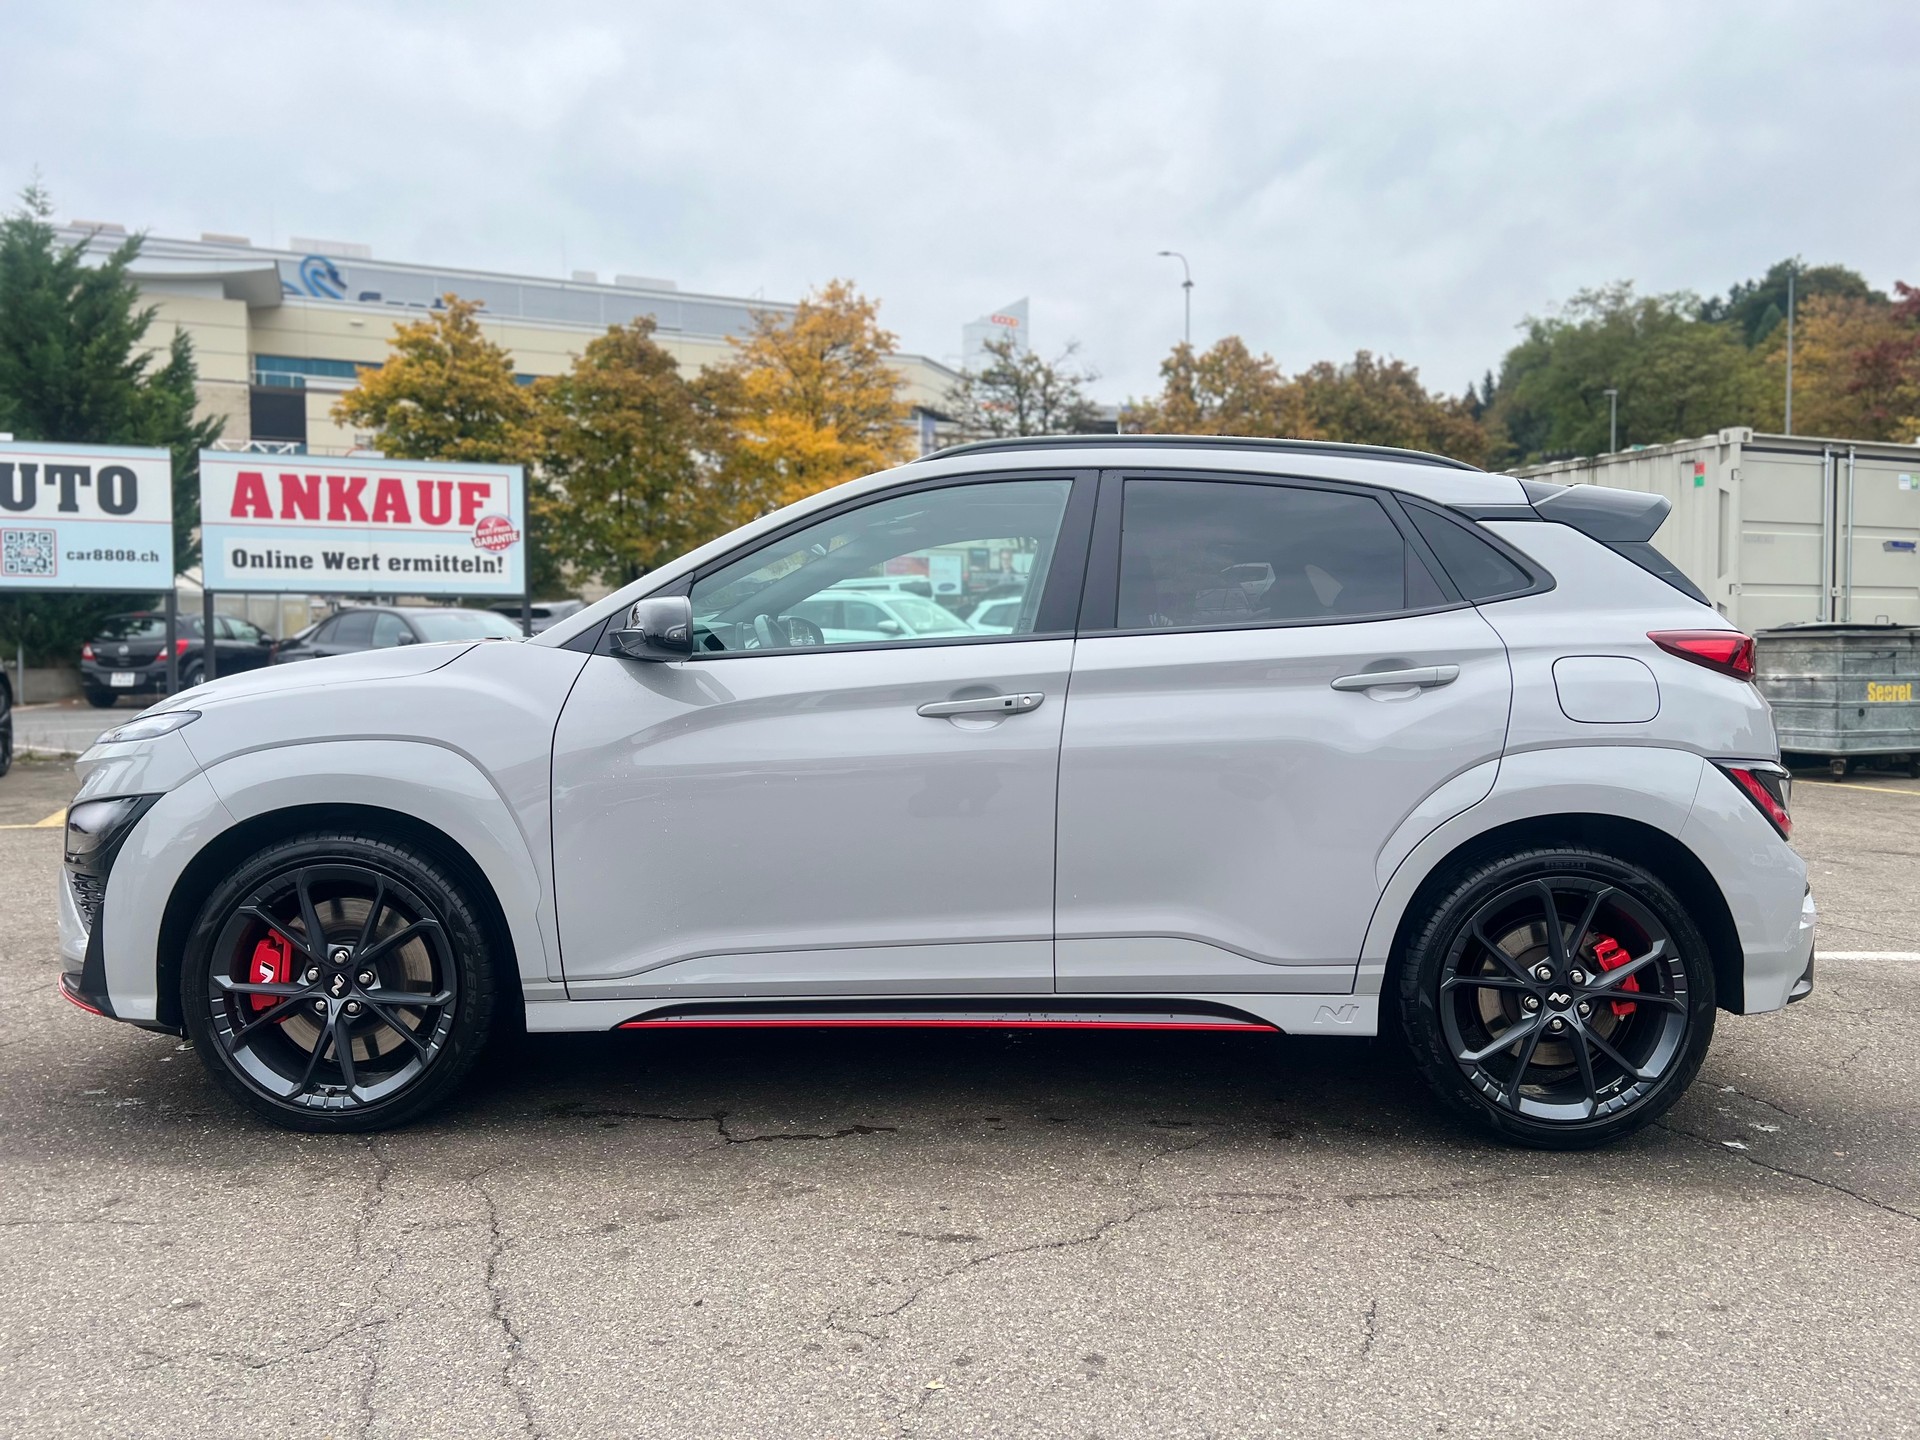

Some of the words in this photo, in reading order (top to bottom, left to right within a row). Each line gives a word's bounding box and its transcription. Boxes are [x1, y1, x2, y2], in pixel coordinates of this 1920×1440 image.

[230, 471, 491, 526] ANKAUF
[474, 531, 518, 547] GARANTIE
[66, 549, 160, 563] car8808.ch
[231, 548, 314, 569] Online
[321, 551, 380, 571] Wert
[387, 554, 504, 574] ermitteln!
[1867, 681, 1912, 703] Secret
